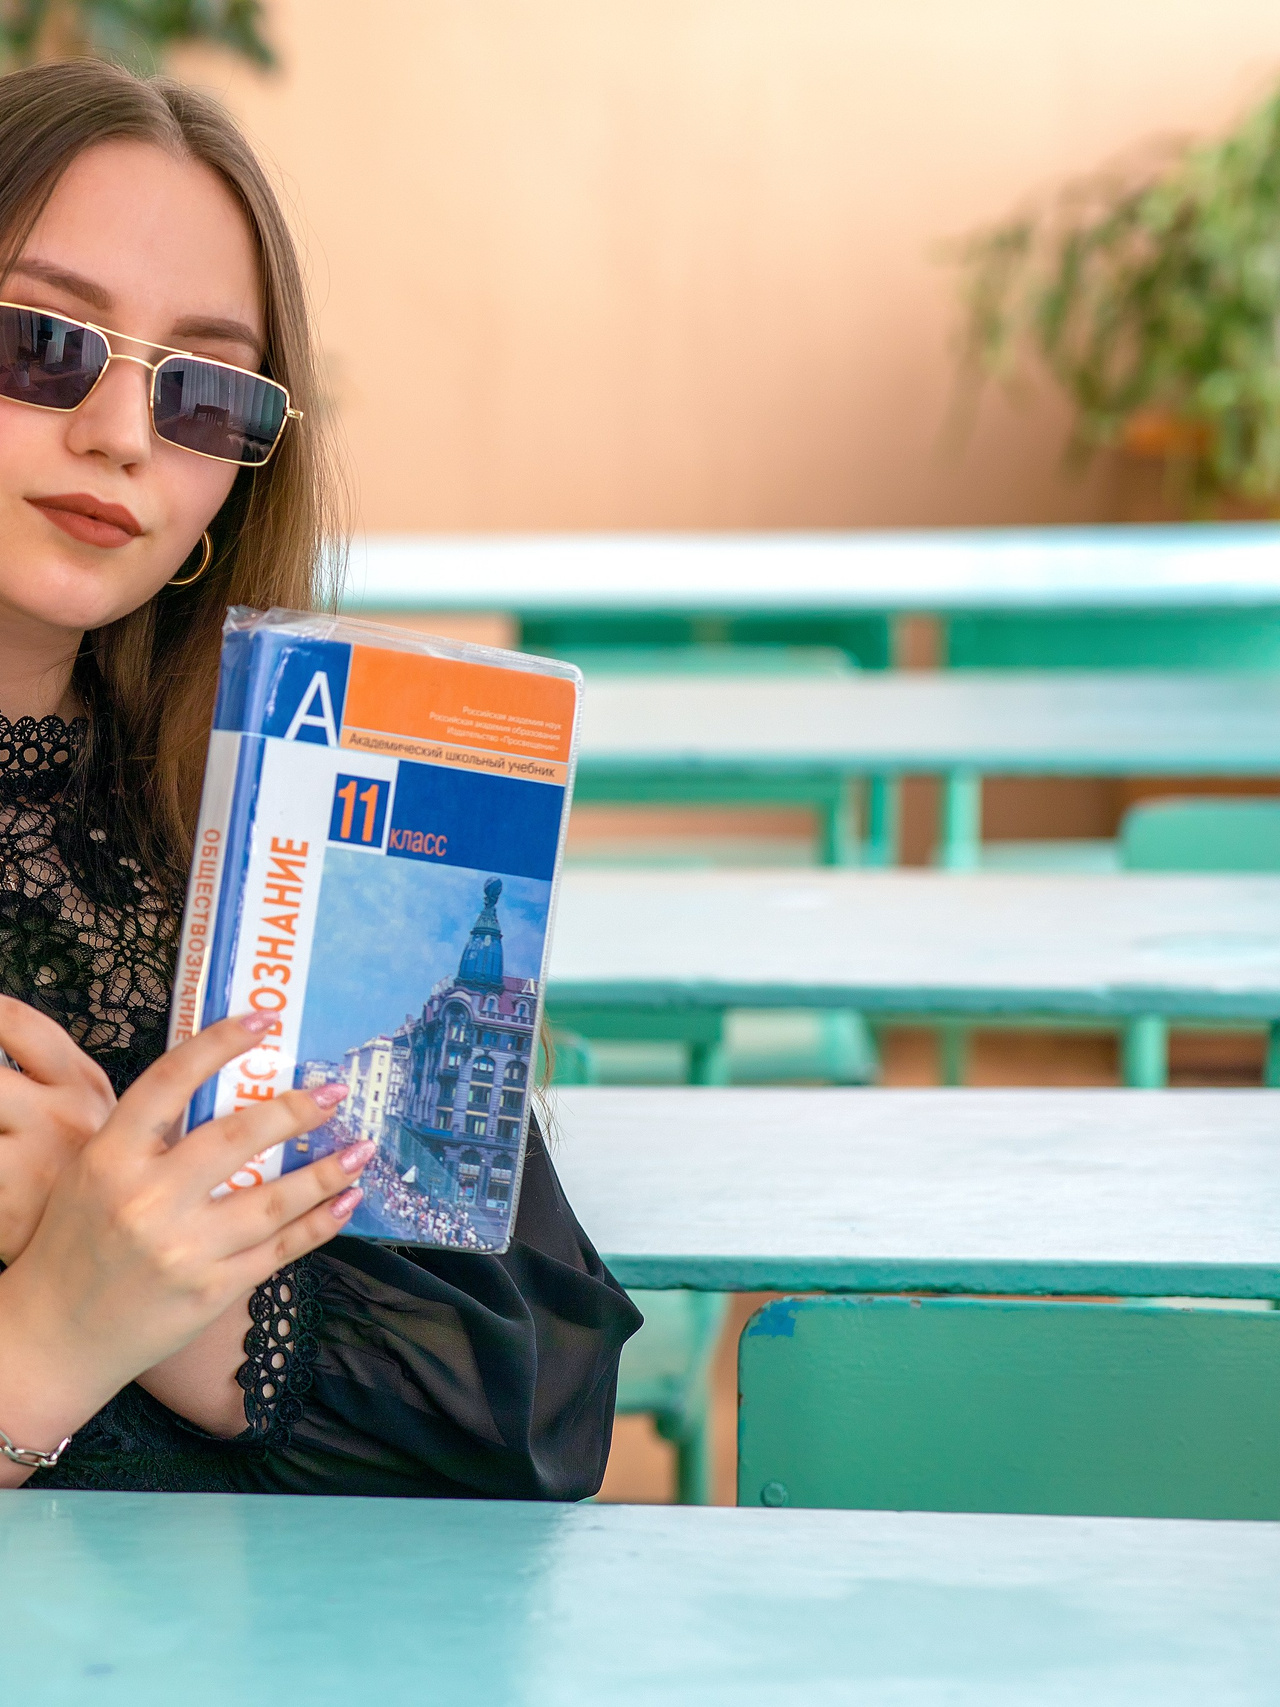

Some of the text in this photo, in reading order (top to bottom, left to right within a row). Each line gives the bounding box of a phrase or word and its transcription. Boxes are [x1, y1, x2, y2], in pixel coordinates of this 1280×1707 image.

[284, 670, 338, 748] А
[429, 711, 473, 726] Российская
[462, 705, 507, 720] Российская
[348, 732, 556, 778] Академический школьный учебник
[338, 780, 448, 857] 11 класс
[175, 829, 221, 1041] ОБЩЕСТВОЗНАНИЕ
